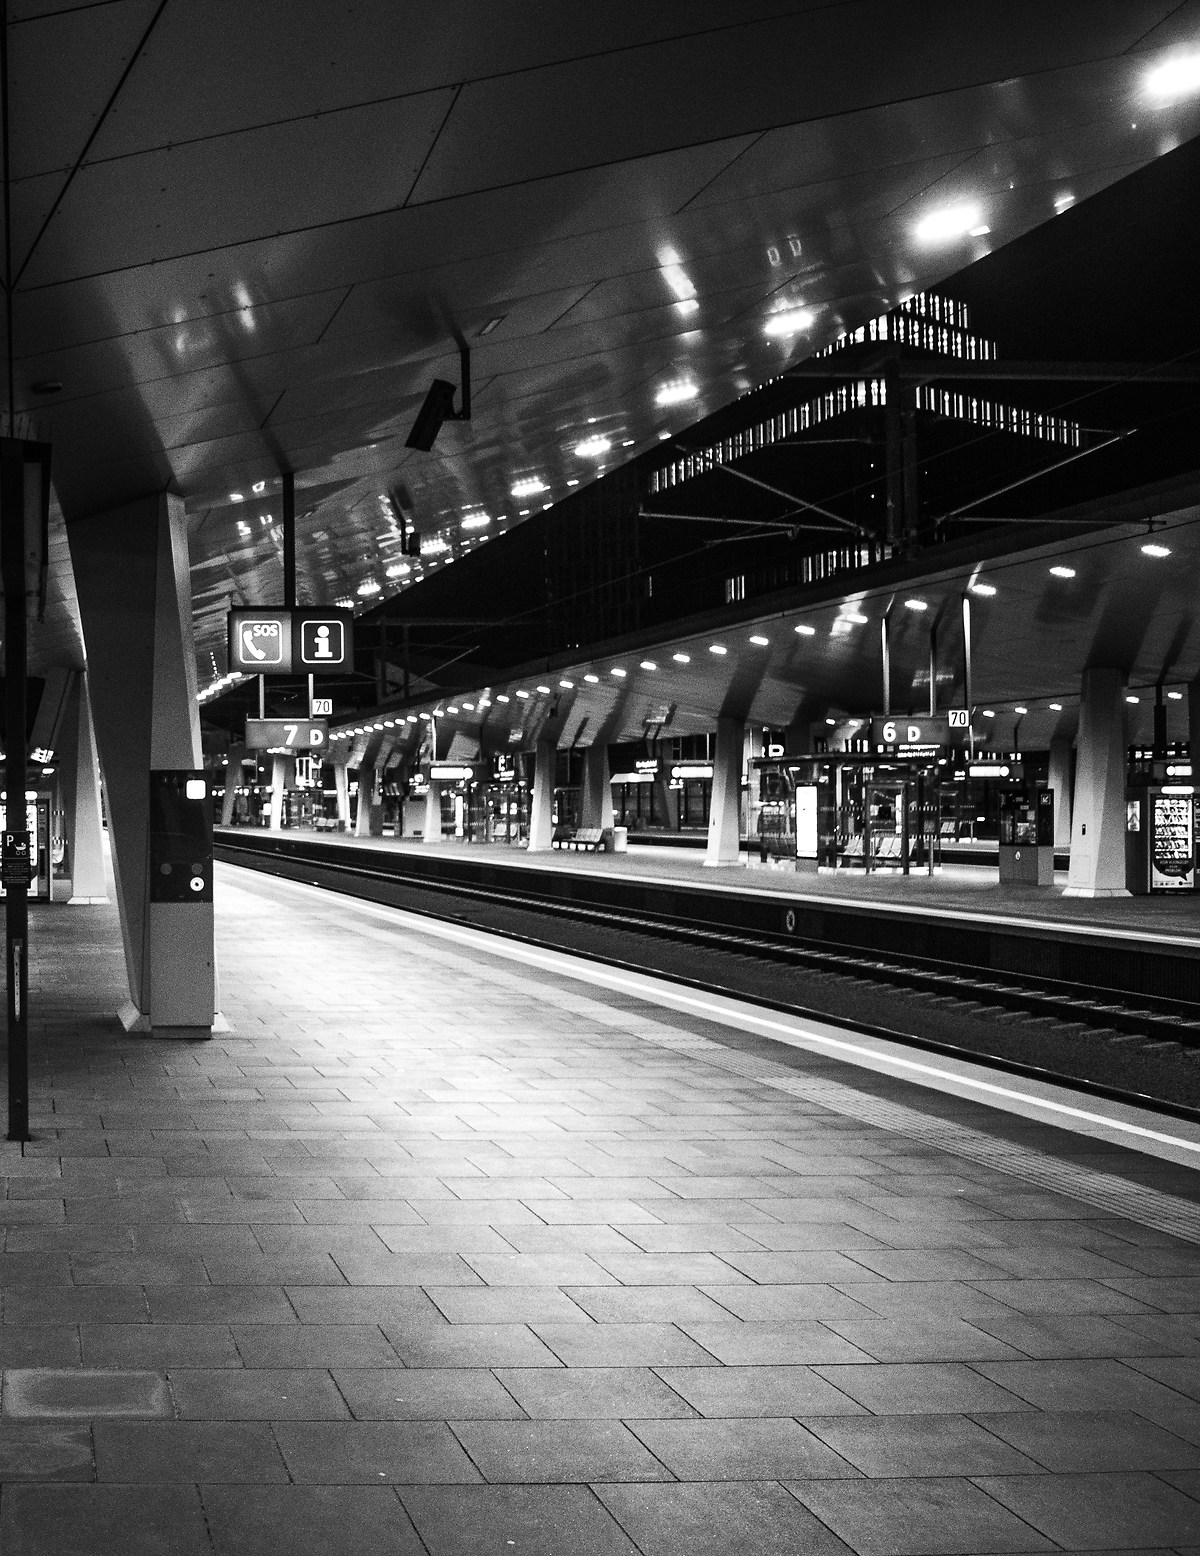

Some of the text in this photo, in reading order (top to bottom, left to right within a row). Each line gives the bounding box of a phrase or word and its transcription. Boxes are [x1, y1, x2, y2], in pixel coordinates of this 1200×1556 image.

[253, 624, 278, 637] SOS
[315, 701, 330, 713] 70
[951, 712, 966, 725] 70
[283, 724, 324, 746] 7 D
[882, 721, 921, 743] 6 D
[6, 834, 14, 847] P
